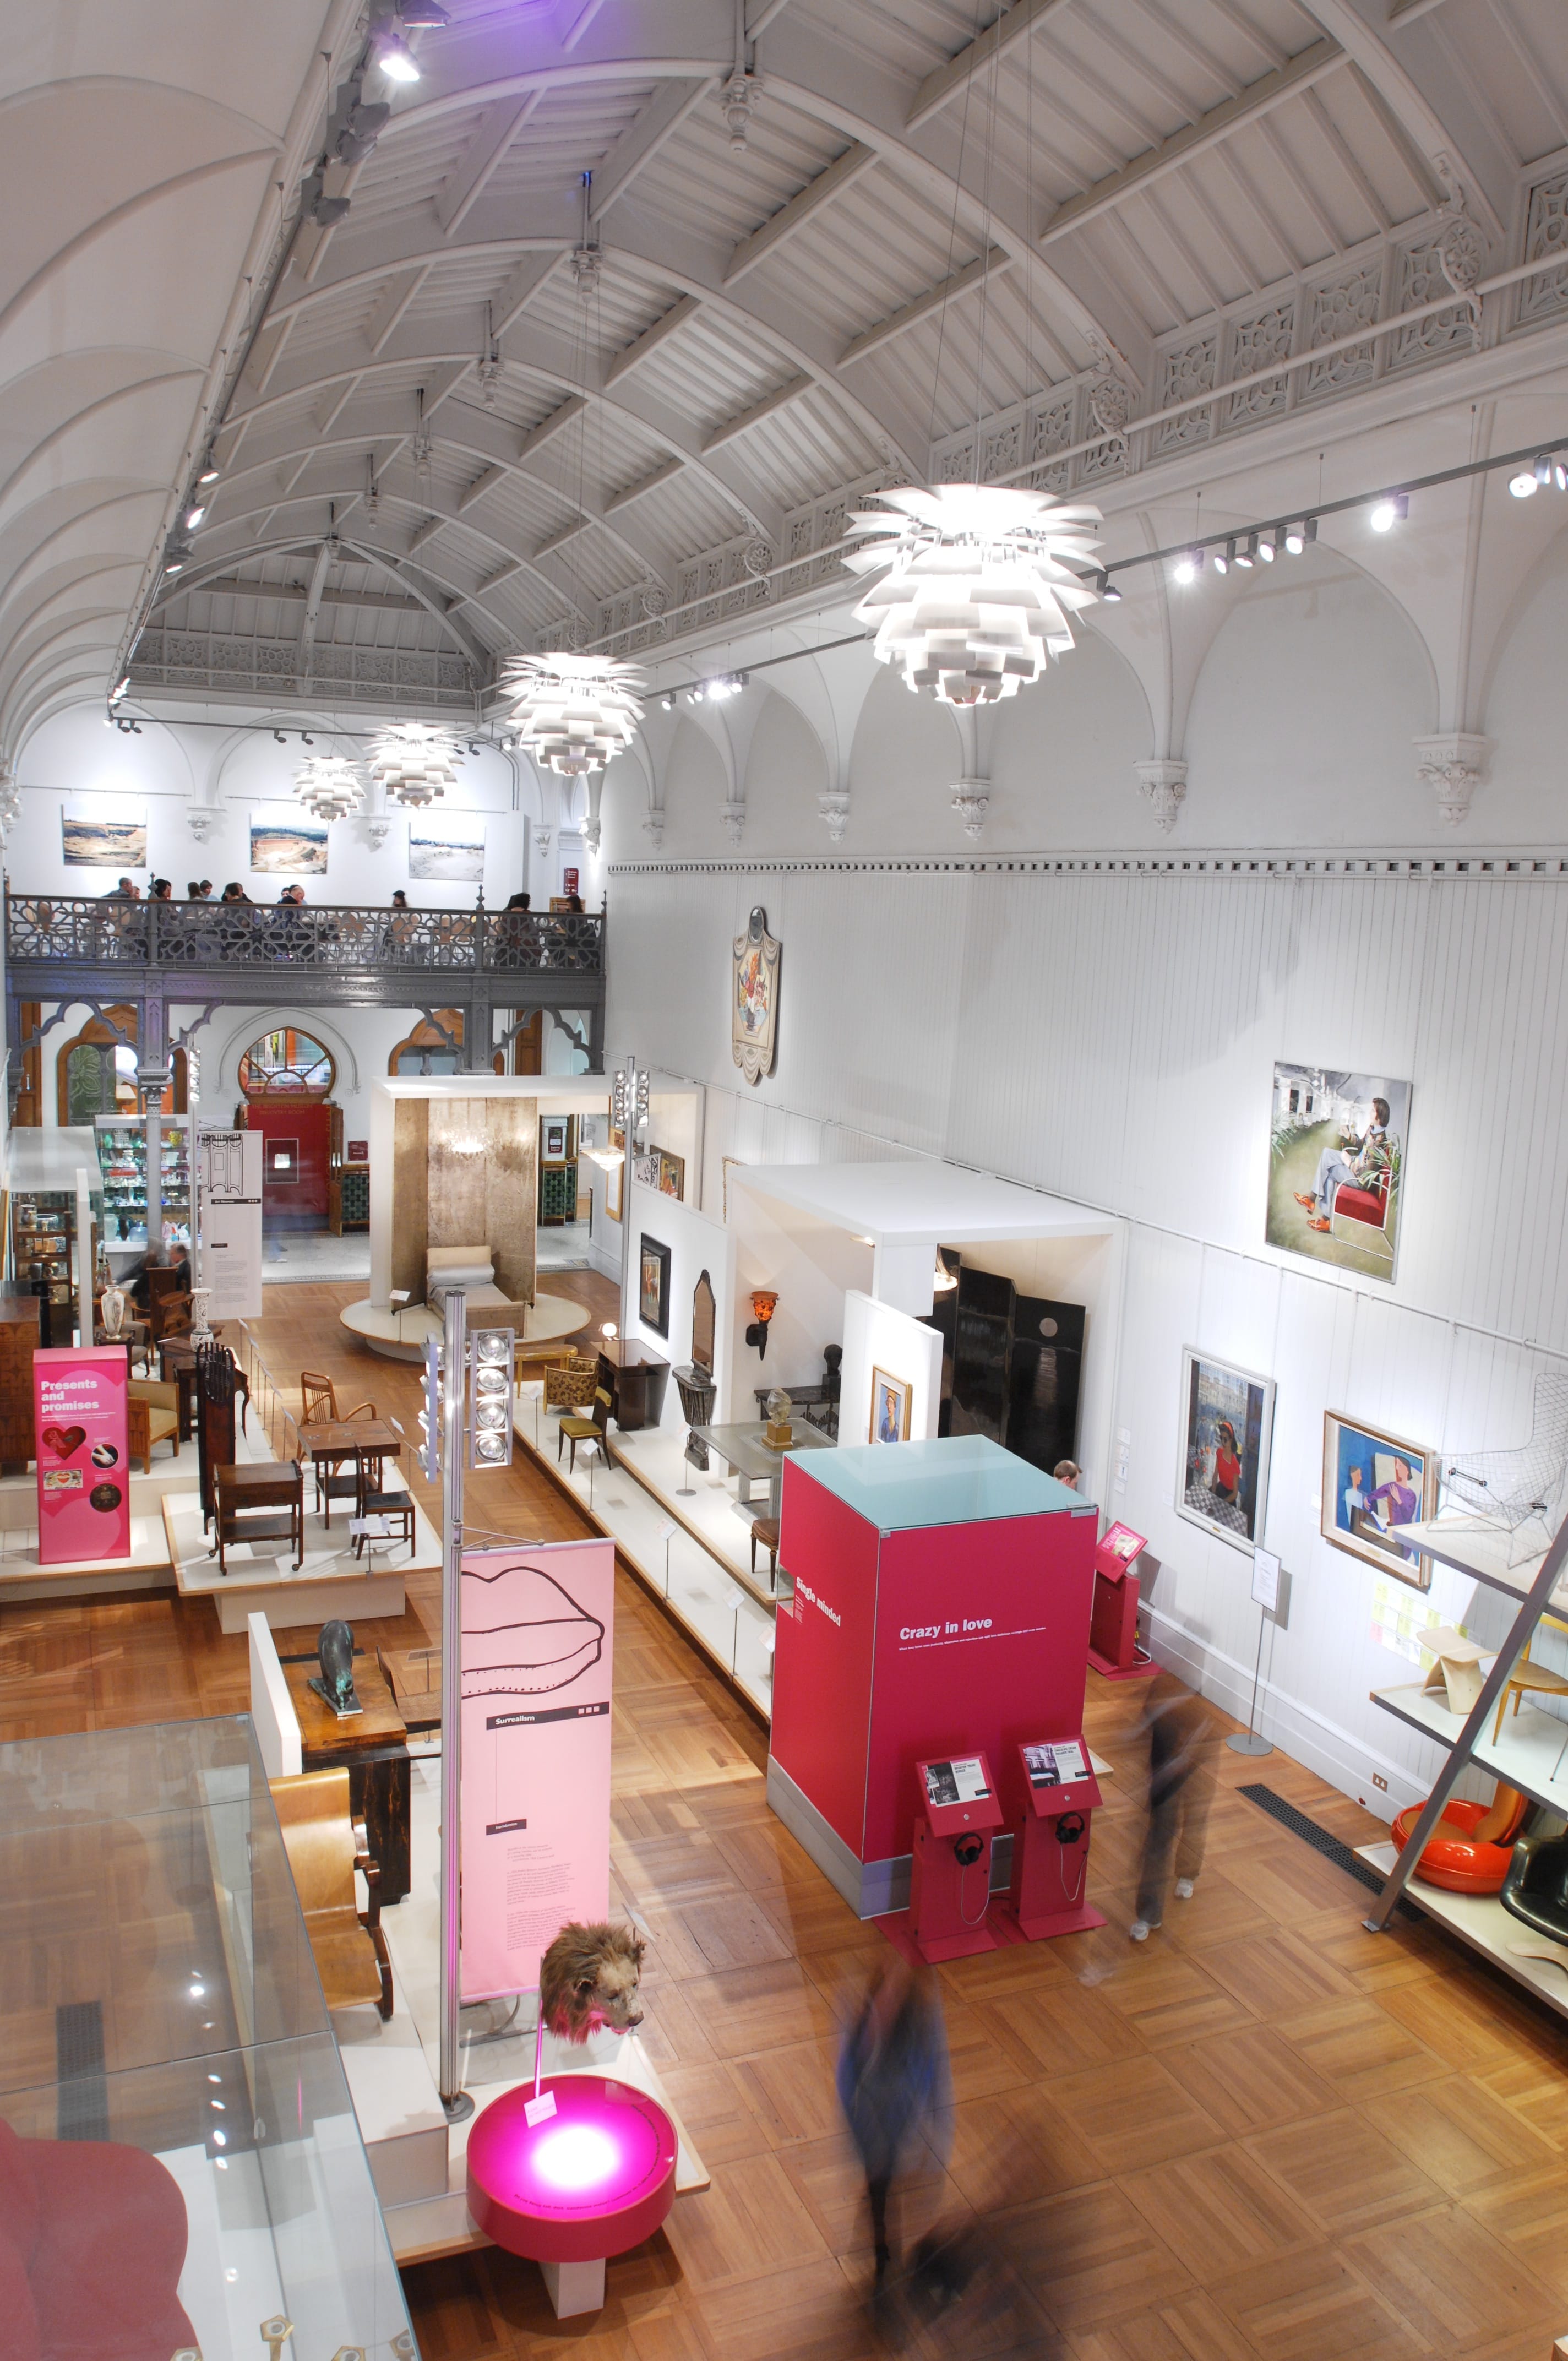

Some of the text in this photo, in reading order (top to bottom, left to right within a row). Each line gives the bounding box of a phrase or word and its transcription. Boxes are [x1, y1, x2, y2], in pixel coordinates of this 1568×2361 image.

[41, 1379, 97, 1391] Presents
[41, 1391, 64, 1401] and
[42, 1400, 99, 1413] promises
[796, 1576, 815, 1603] Single
[816, 1597, 841, 1627] minded
[900, 1618, 993, 1640] Crazy in love
[496, 1715, 535, 1724] Surrealism
